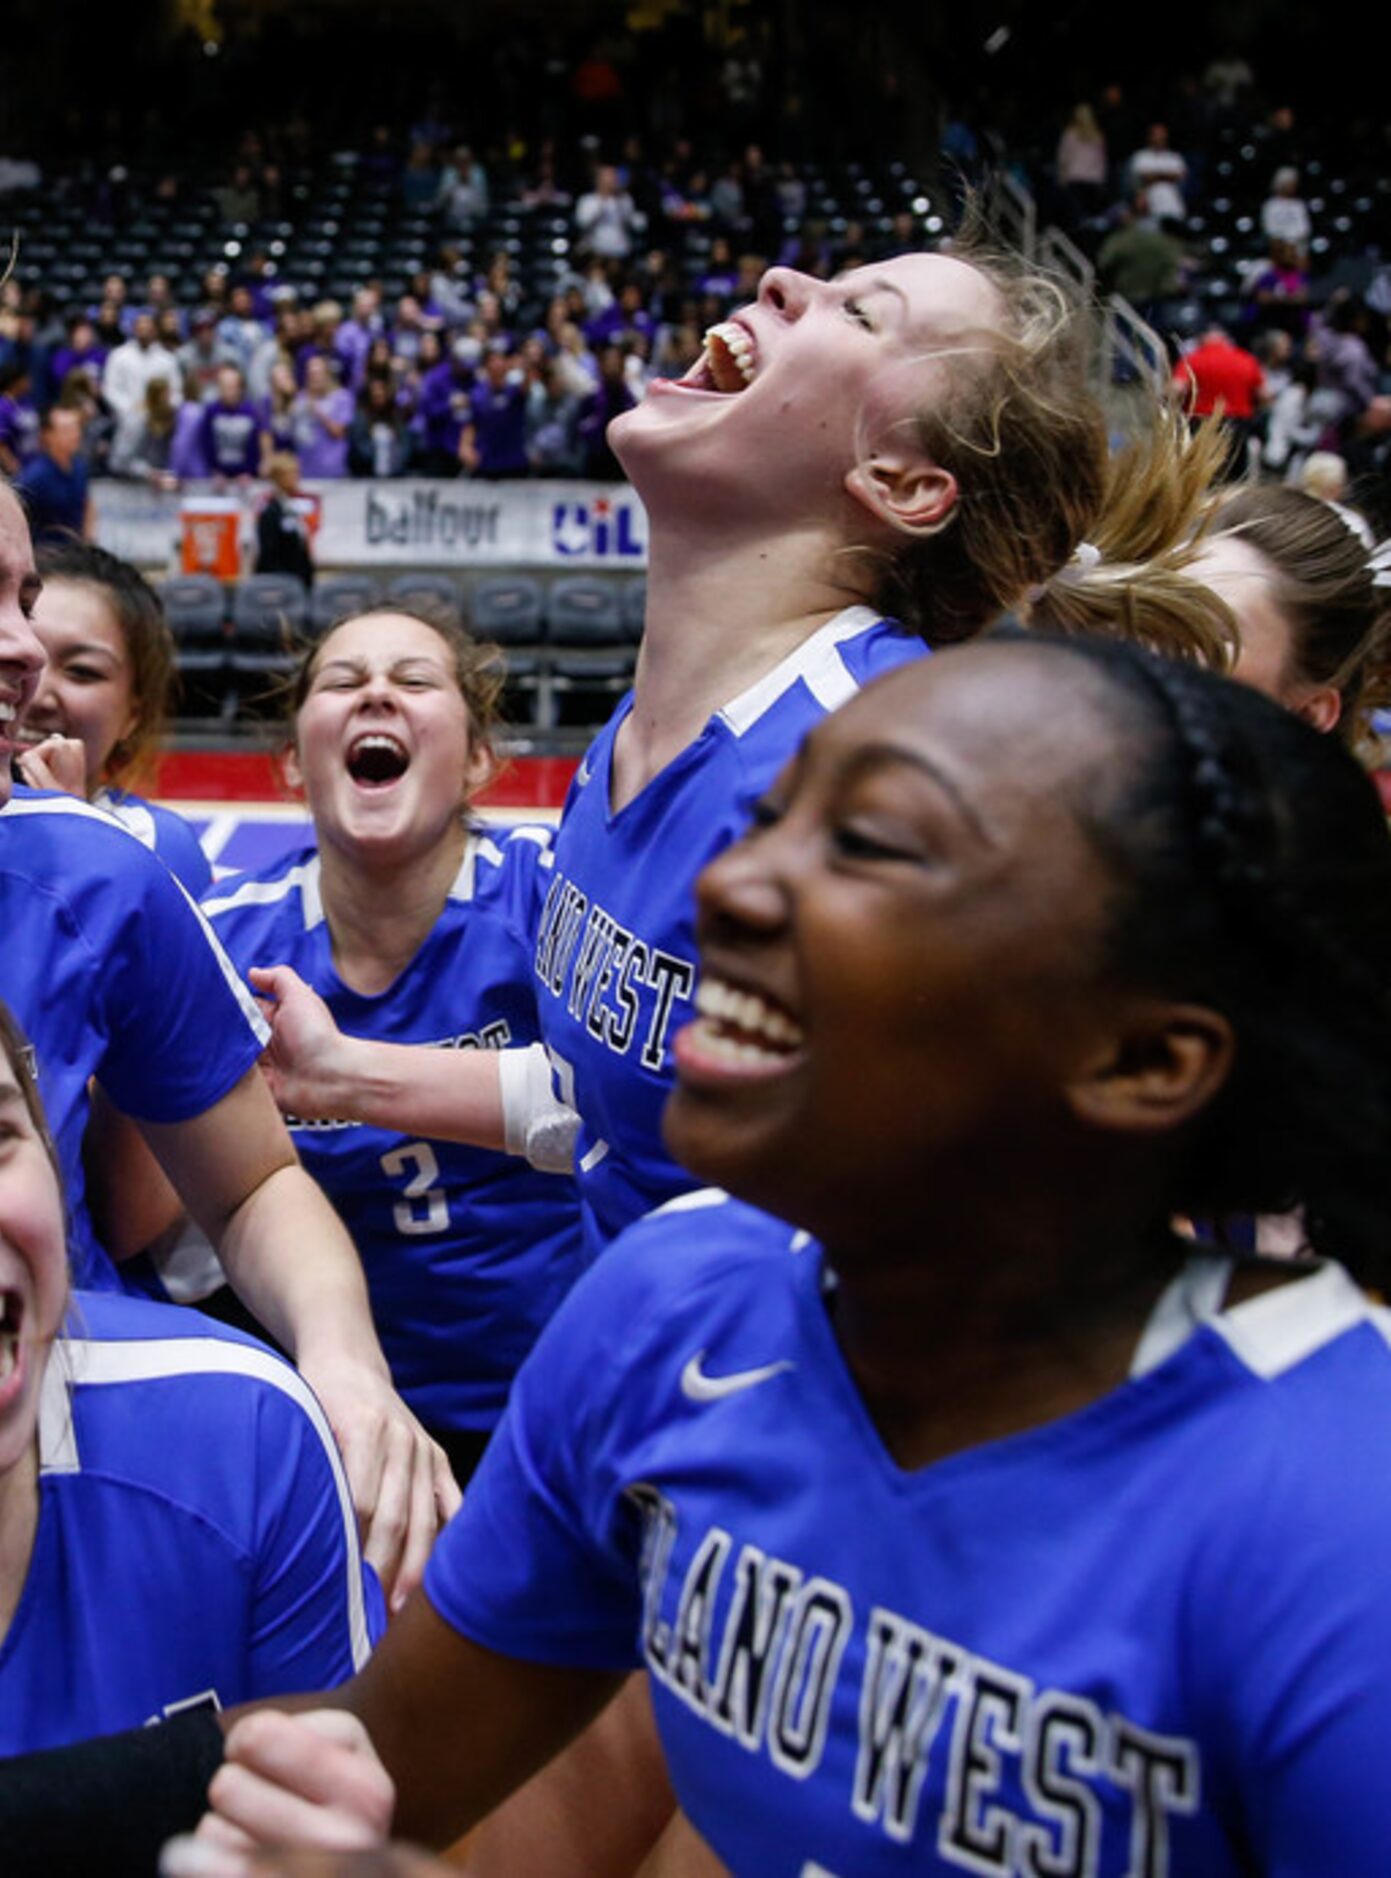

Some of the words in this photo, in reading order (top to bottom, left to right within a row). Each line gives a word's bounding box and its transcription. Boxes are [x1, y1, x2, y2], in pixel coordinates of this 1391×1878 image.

[365, 488, 499, 545] balfour
[567, 904, 695, 1071] WEST
[380, 1142, 450, 1235] 3
[851, 1607, 1200, 1878] WEST
